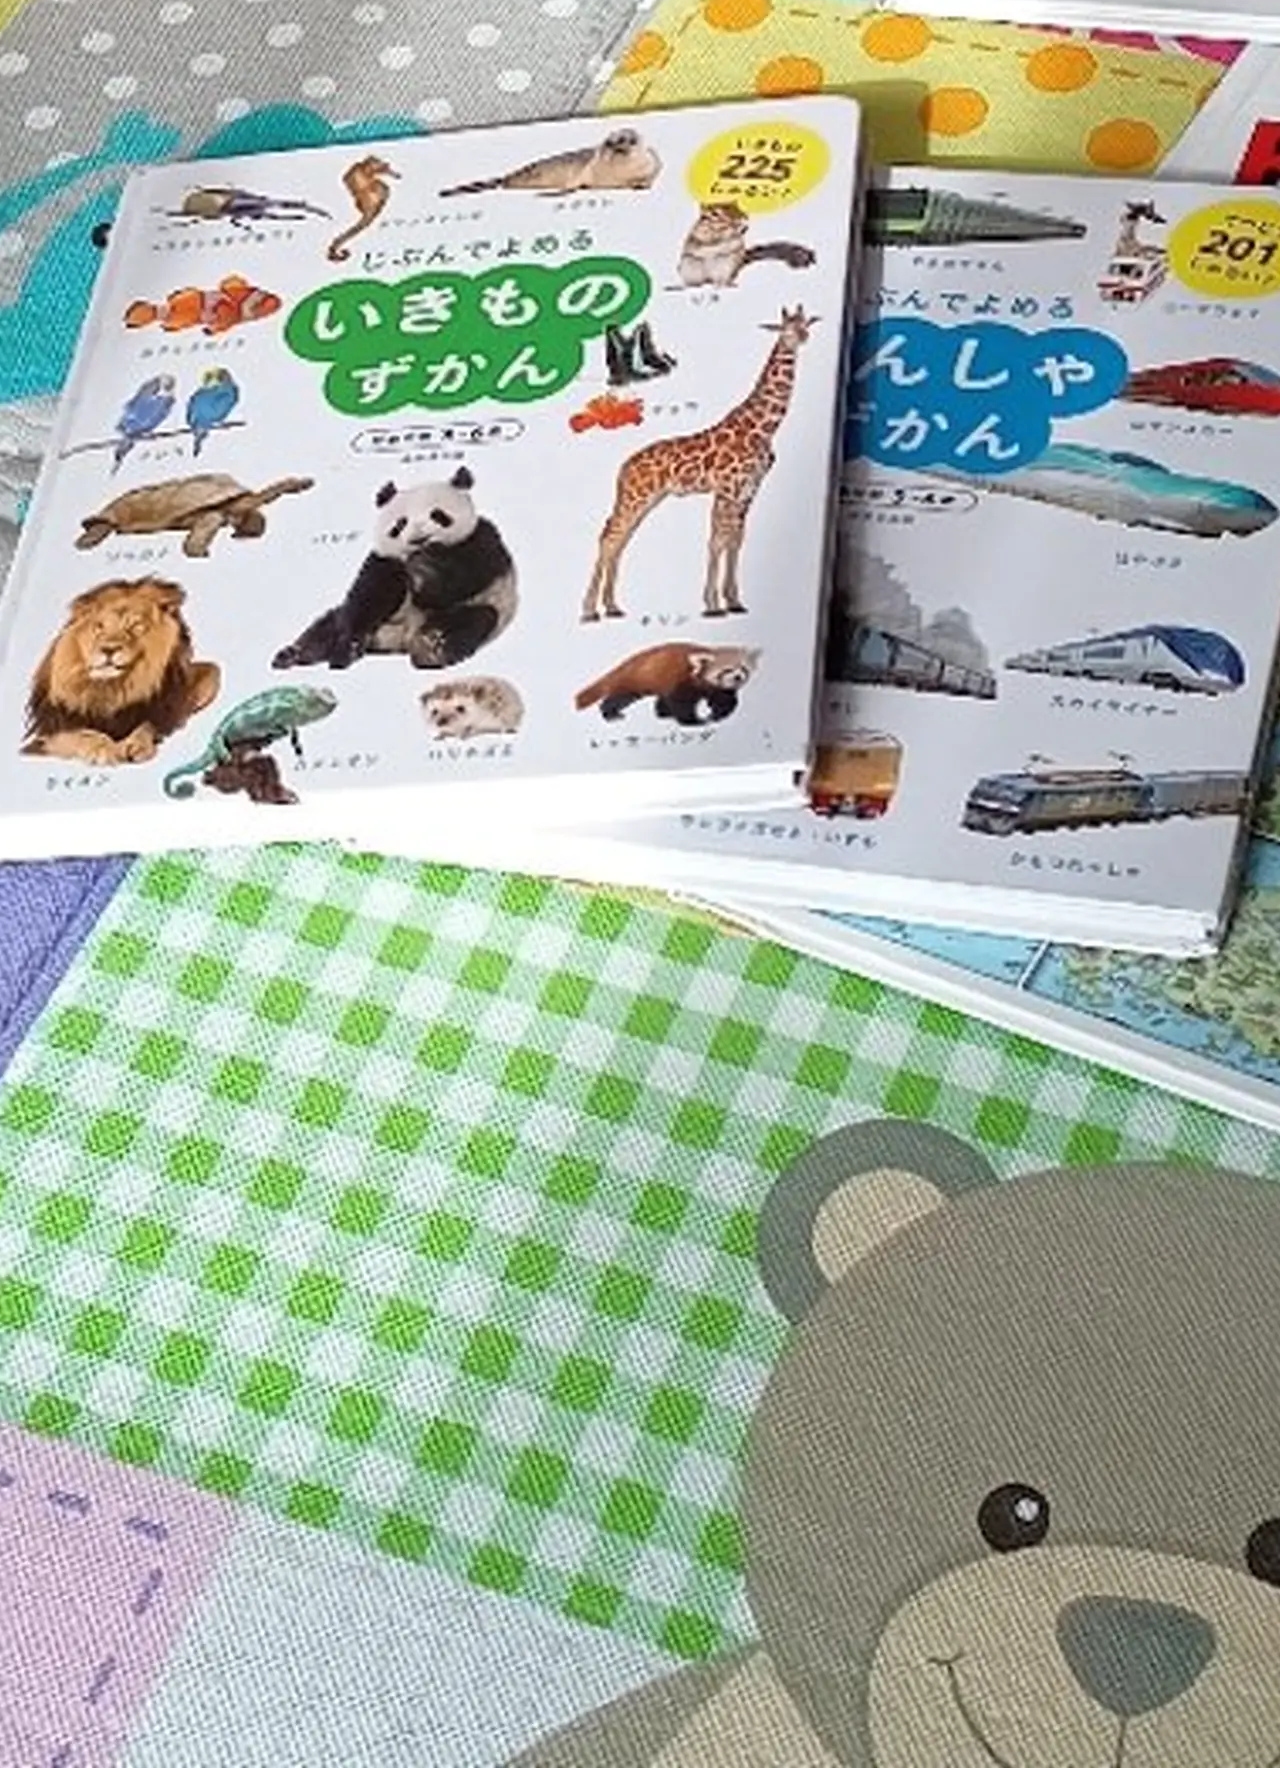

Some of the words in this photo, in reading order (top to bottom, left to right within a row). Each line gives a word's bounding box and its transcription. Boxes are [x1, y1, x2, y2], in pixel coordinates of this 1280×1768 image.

[719, 154, 796, 182] 225
[360, 231, 594, 272] じぶんでよめる
[1199, 230, 1278, 265] 201
[314, 271, 631, 342] いきもの
[352, 343, 558, 400] ずかん
[854, 333, 1095, 396] んしゃ
[850, 404, 1020, 461] かん
